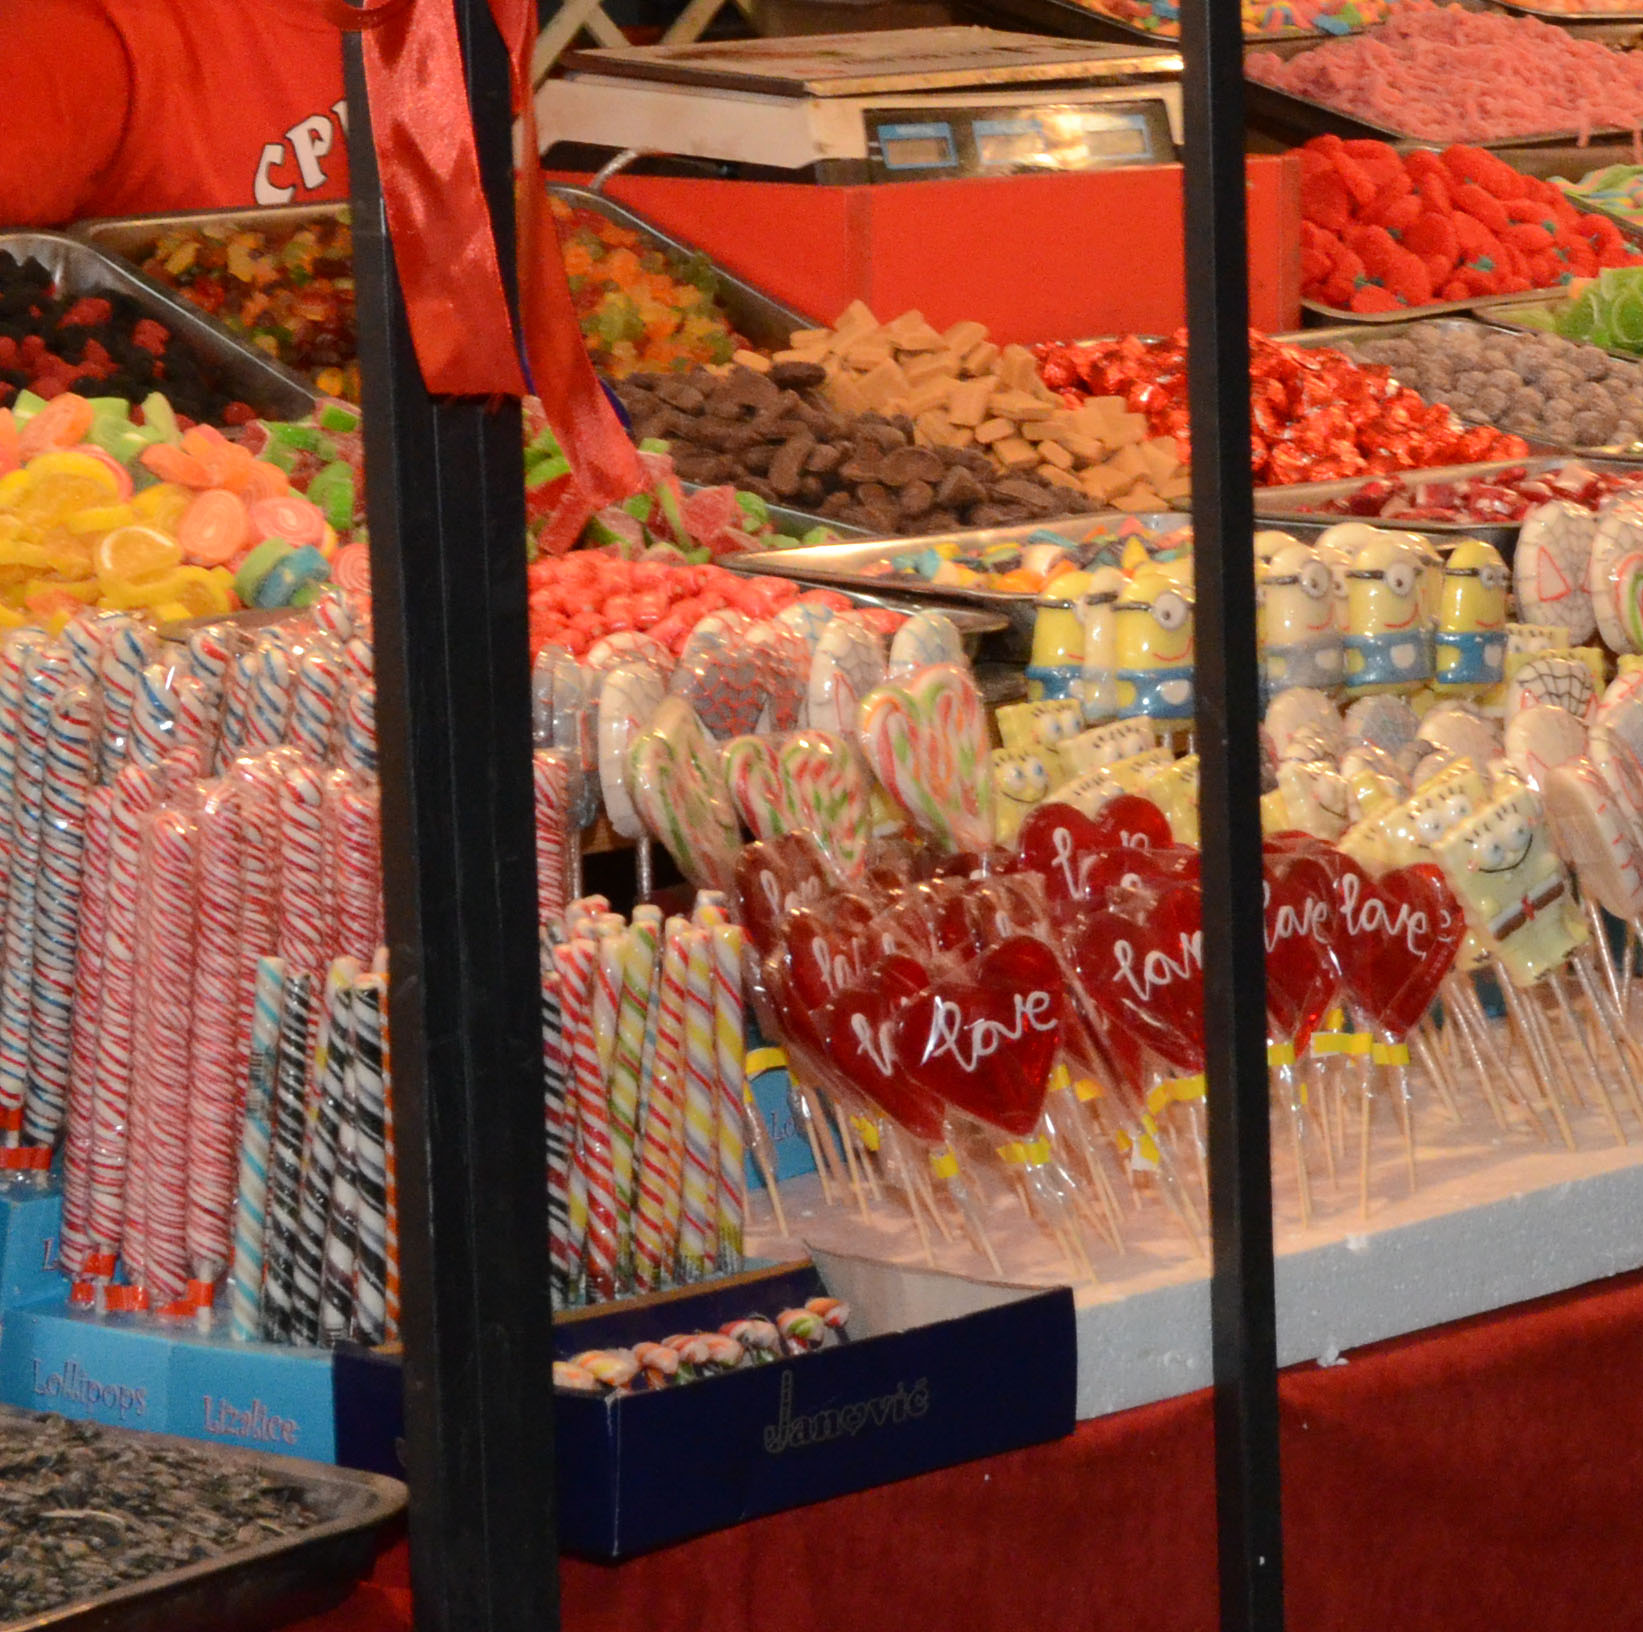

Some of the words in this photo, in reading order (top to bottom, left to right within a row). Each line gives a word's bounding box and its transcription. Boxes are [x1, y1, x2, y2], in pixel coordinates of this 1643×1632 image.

[1339, 872, 1429, 962] love
[932, 990, 1058, 1073] love
[32, 1357, 148, 1418] Lollipops
[203, 1393, 301, 1446] Lizalice
